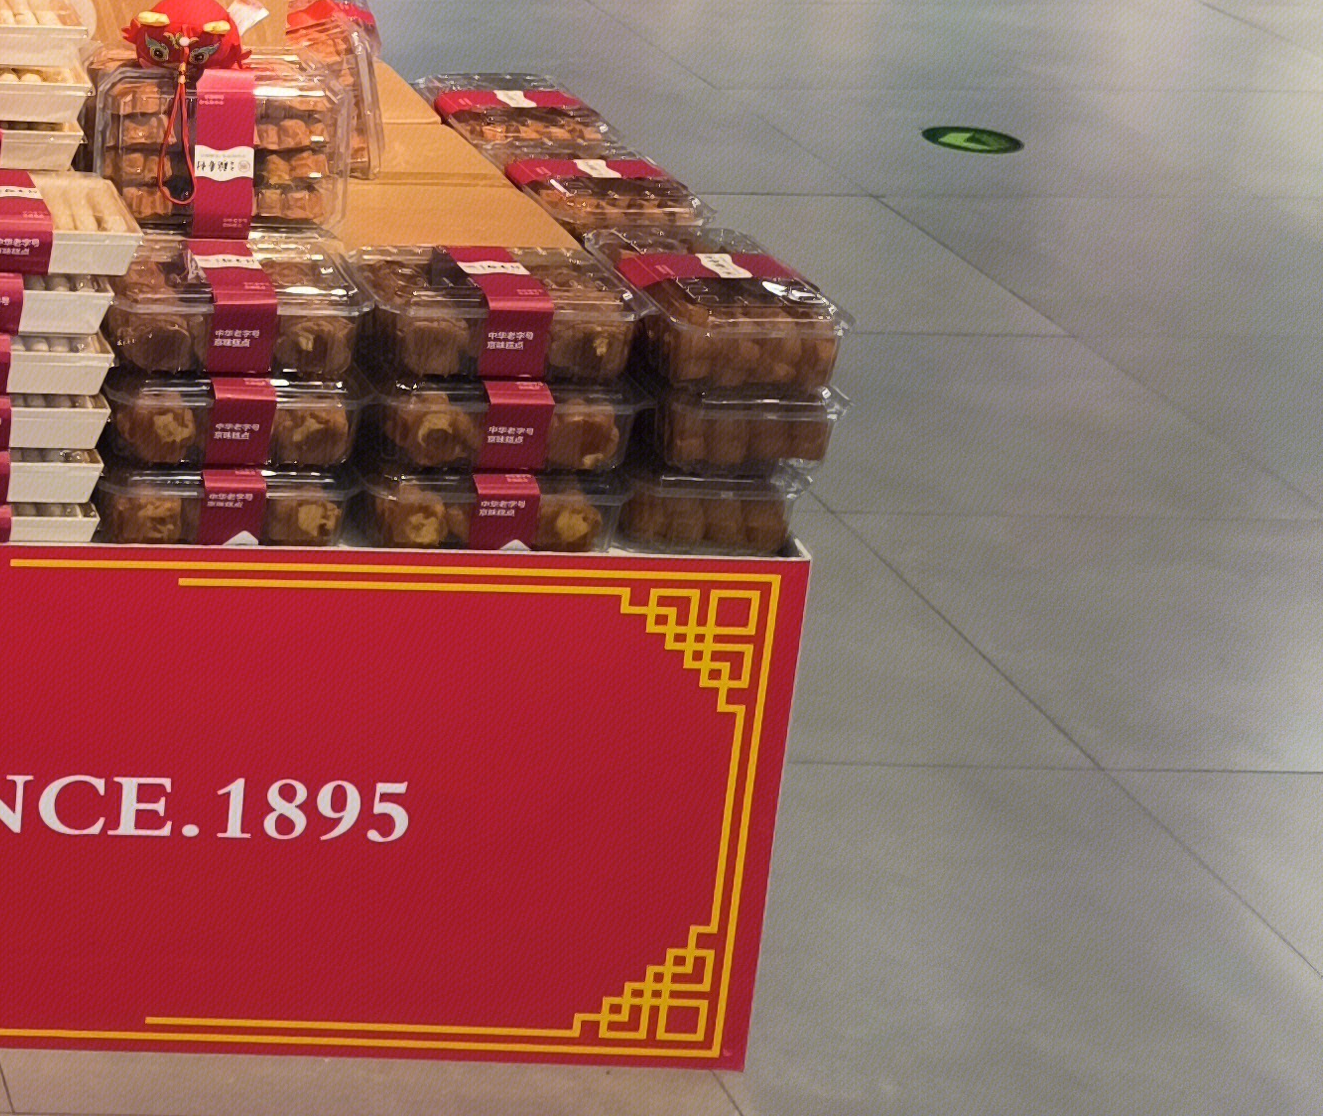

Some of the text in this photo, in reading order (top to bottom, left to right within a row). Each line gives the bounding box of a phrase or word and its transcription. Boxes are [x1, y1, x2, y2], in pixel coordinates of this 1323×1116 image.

[214, 329, 261, 338] 中华老字号
[487, 331, 534, 340] 中华老字号
[215, 423, 261, 432] 中华老字号
[488, 425, 534, 435] 中华老字号
[208, 493, 254, 502] 中华老字号
[479, 499, 526, 508] 中华老字号
